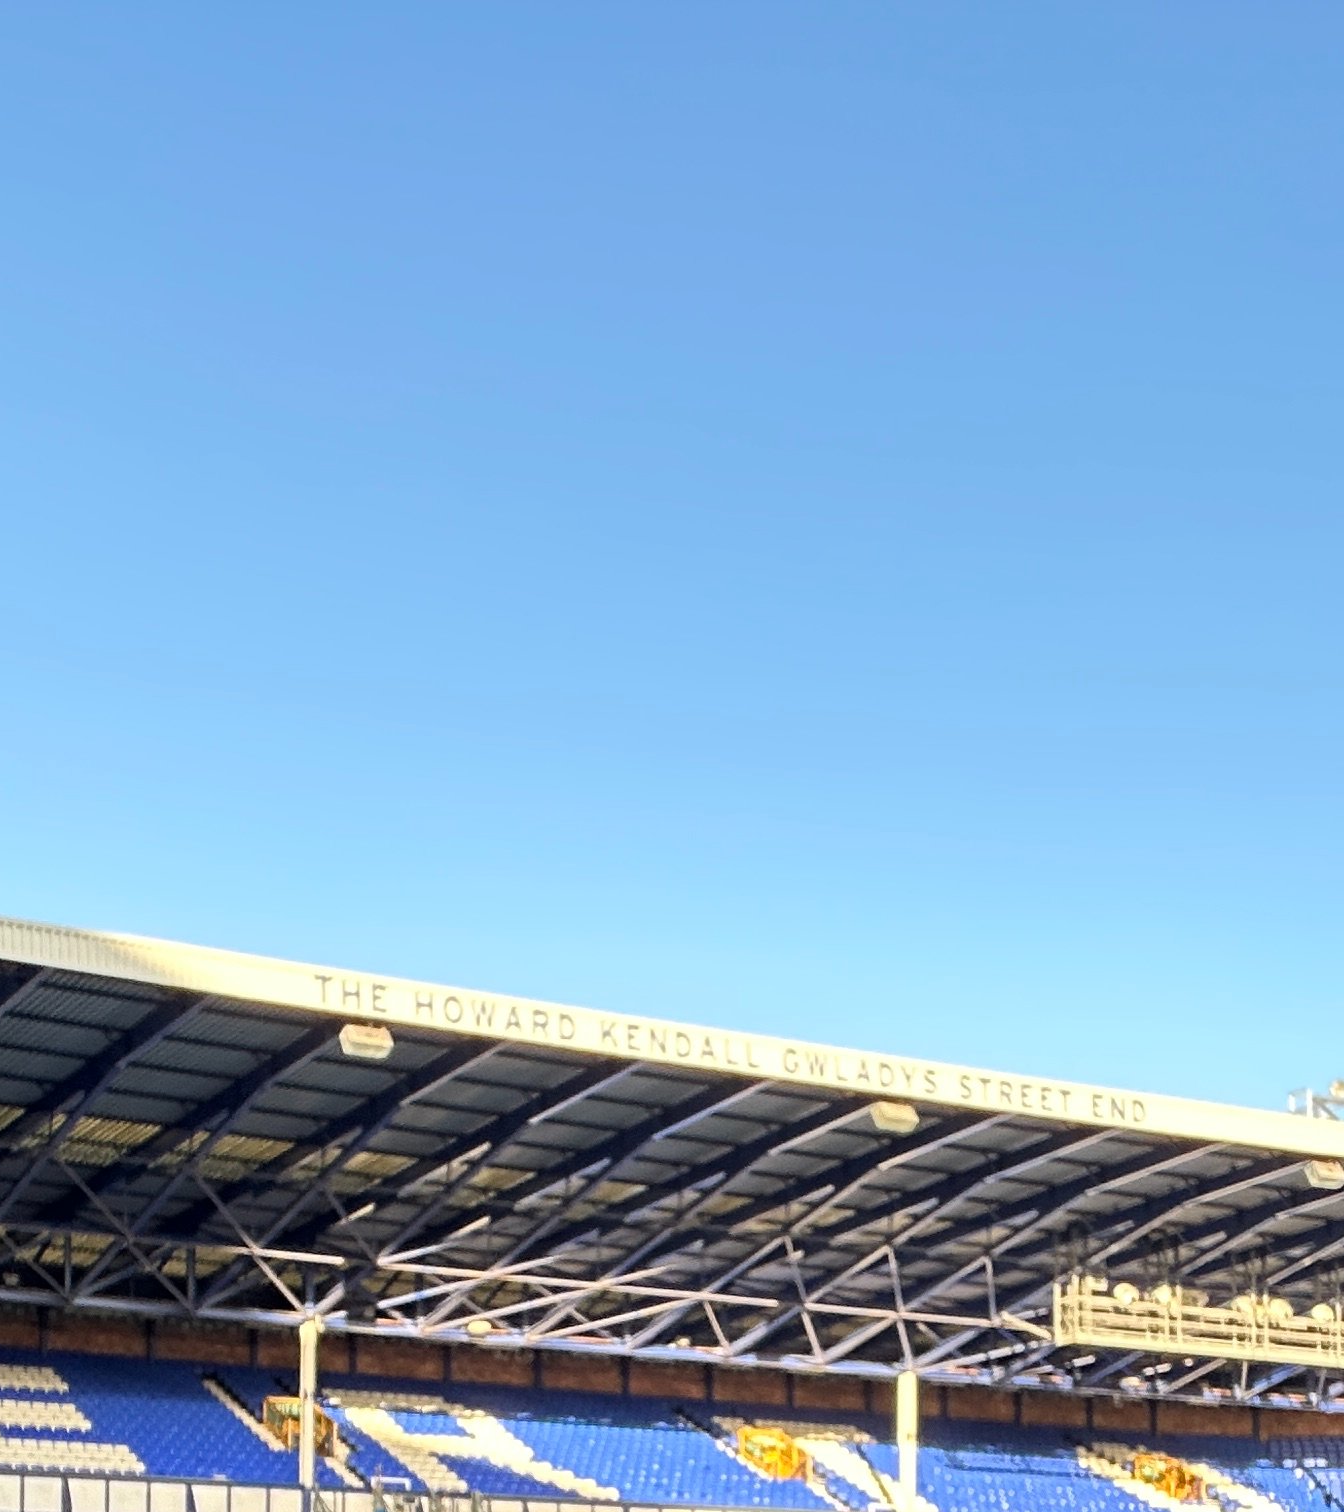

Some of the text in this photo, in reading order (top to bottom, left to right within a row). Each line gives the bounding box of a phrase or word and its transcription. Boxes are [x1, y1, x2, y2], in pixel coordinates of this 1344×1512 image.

[314, 974, 1147, 1123] THE HOWARD KENDALL GWLADYS STREET END
